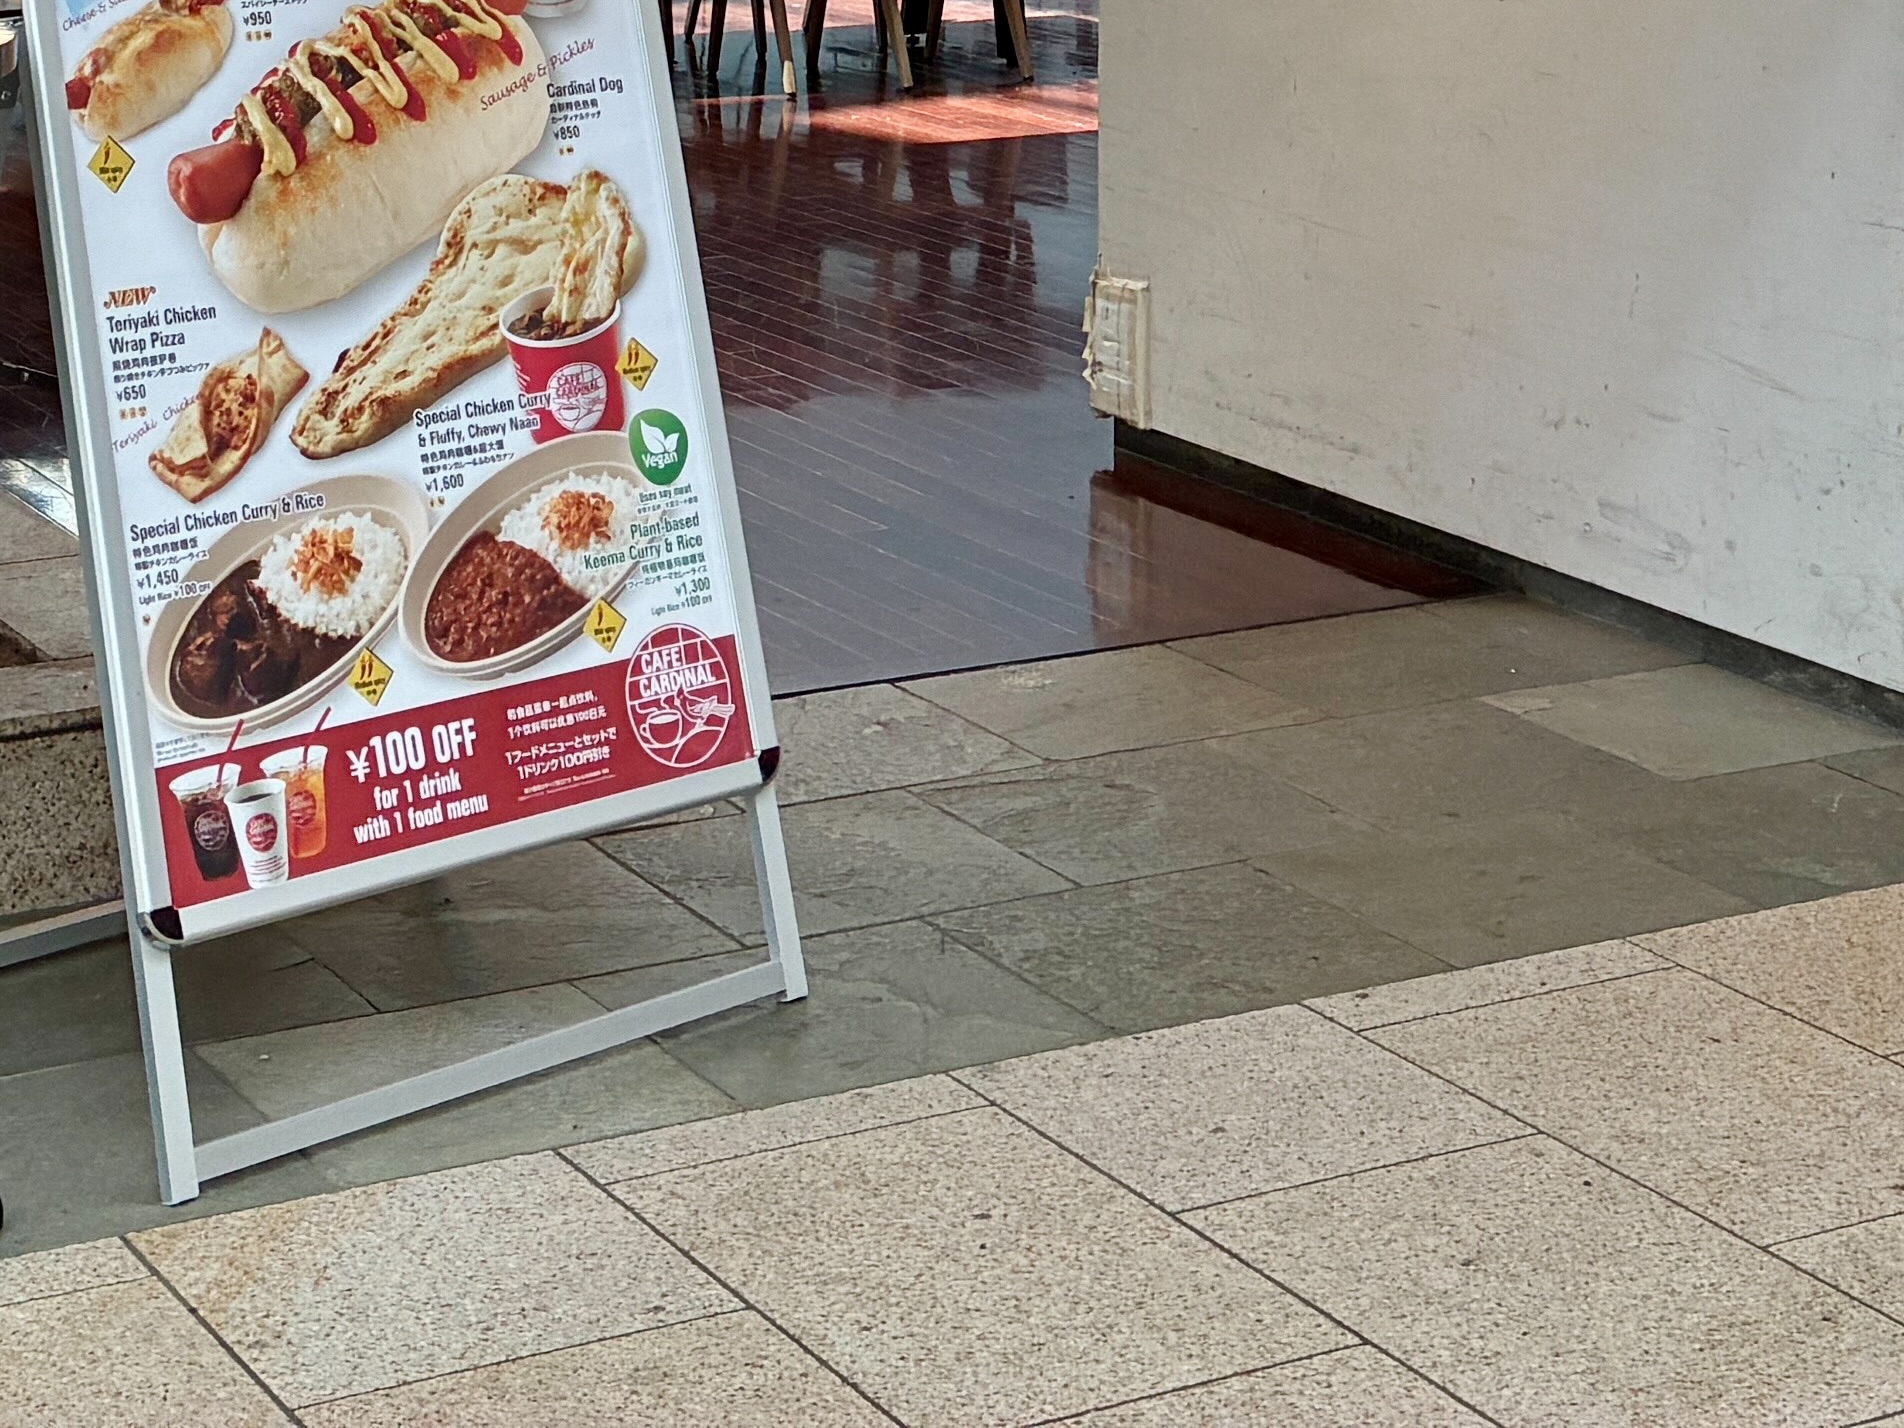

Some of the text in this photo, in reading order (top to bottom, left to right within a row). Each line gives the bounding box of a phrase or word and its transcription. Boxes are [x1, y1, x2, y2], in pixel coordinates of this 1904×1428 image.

[243, 11, 272, 27] ¥950
[480, 37, 595, 112] Sausage & Pickles
[546, 76, 624, 99] Cardinal Dog
[553, 125, 581, 141] ¥850
[103, 286, 156, 309] NEW
[105, 305, 217, 333] Teriyaki Chicken
[108, 331, 186, 355] Wrap Pizza
[116, 386, 146, 403] ¥650
[415, 392, 551, 429] Special Chicken Curry
[112, 419, 157, 453] Teriyaki
[418, 415, 539, 448] & Fluffy, Chewy Naan
[641, 450, 679, 469] Vegan
[425, 473, 464, 493] ¥1,600
[130, 493, 324, 543] Special Chicken Curry & Rice
[630, 511, 700, 540] Plant-based
[584, 534, 703, 570] Keema Curry & Rice
[137, 568, 179, 591] ¥1,450
[675, 576, 711, 597] ¥1,300
[640, 646, 681, 674] CAFE
[638, 662, 717, 696] CARDINAL
[345, 717, 477, 783] ¥100 OFF
[517, 746, 610, 779] 1ドリンク100円引き
[372, 768, 462, 811] for 1 drink
[352, 792, 489, 844] with 1 food menu
